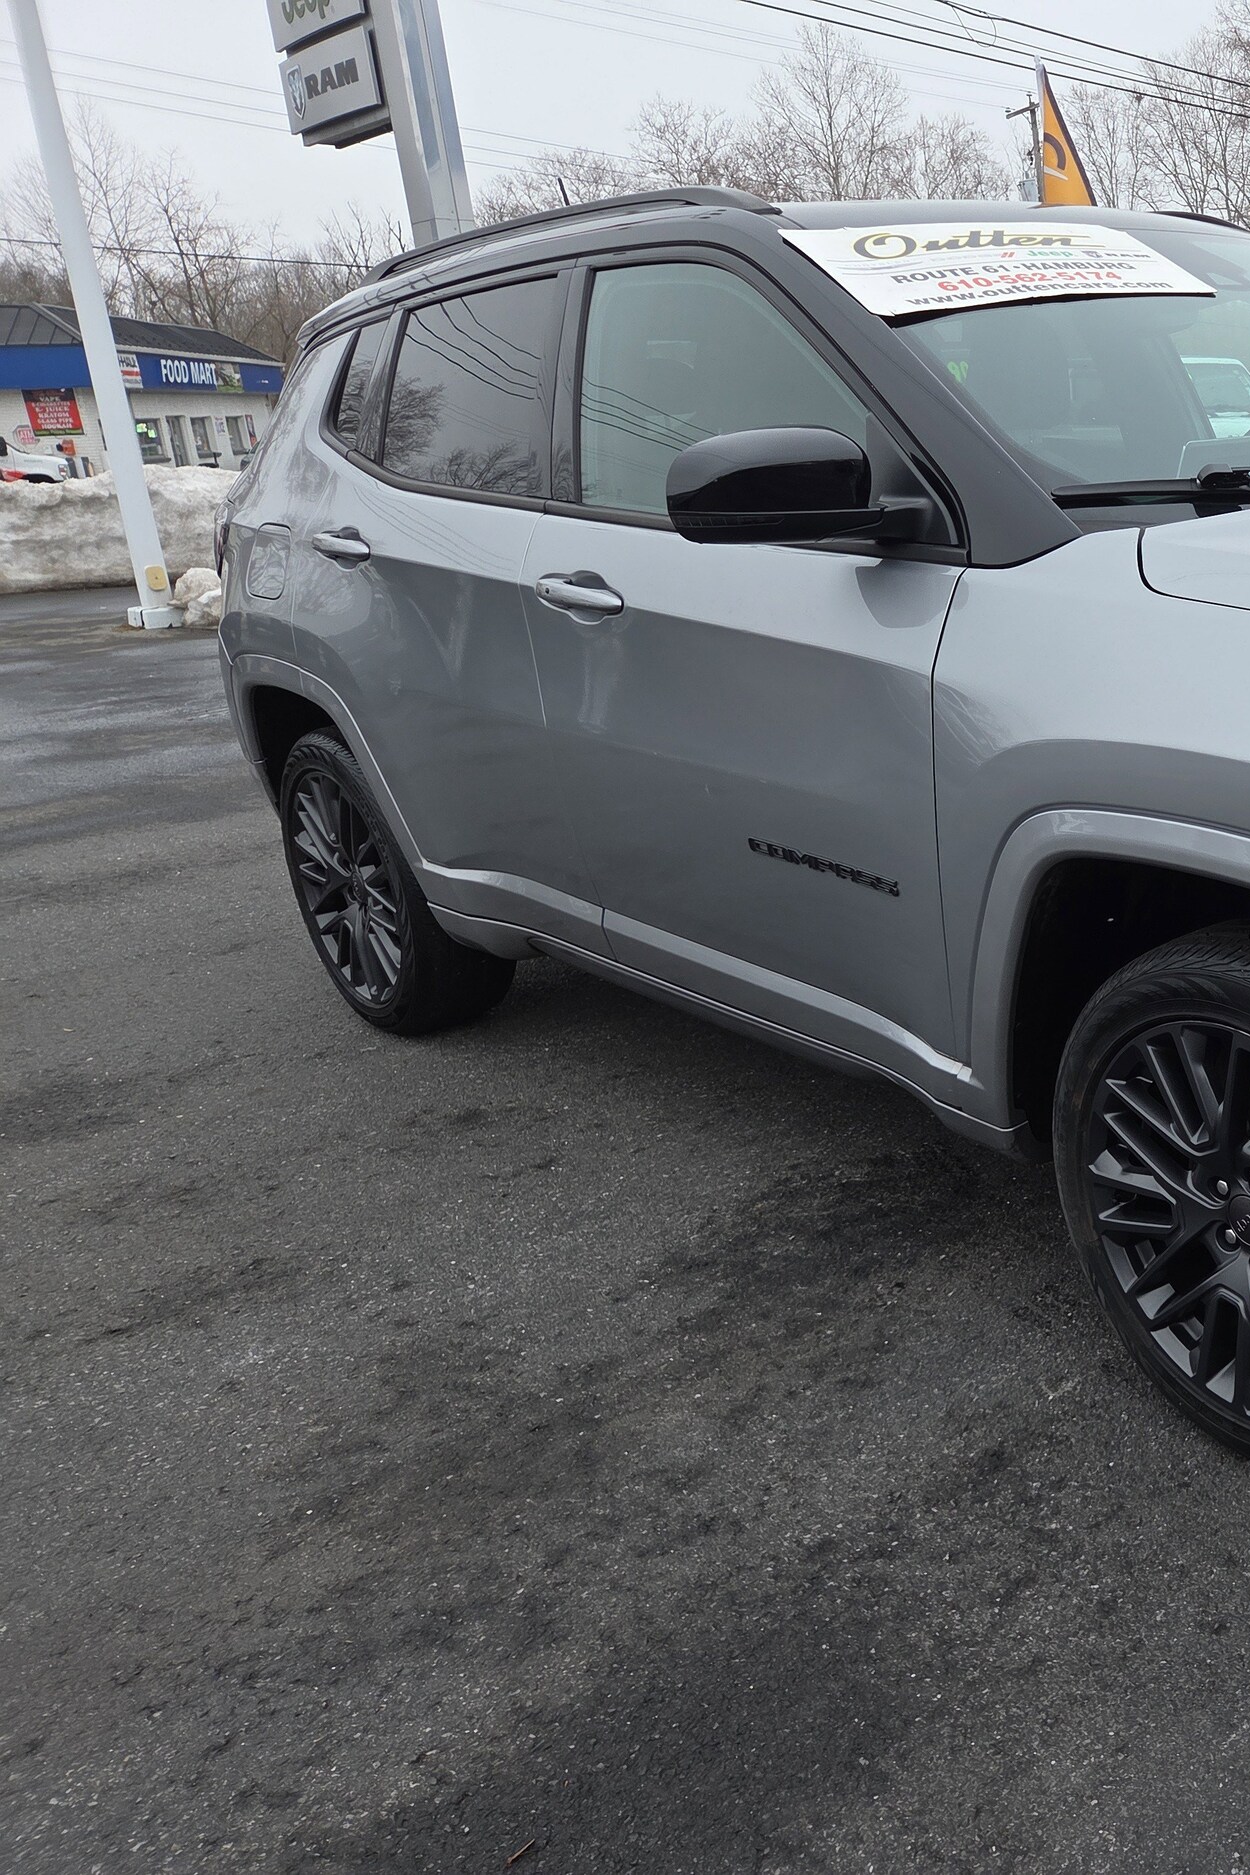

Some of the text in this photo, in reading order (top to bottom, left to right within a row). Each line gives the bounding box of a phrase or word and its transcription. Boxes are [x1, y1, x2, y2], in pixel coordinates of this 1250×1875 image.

[304, 57, 359, 100] RAM
[853, 230, 1105, 260] Outten
[890, 262, 1137, 284] ROUTE 61 HAMBURG
[937, 271, 1122, 292] 610-562-5174
[905, 281, 1174, 306] www.outtencars.com
[160, 359, 217, 385] FOOD MART
